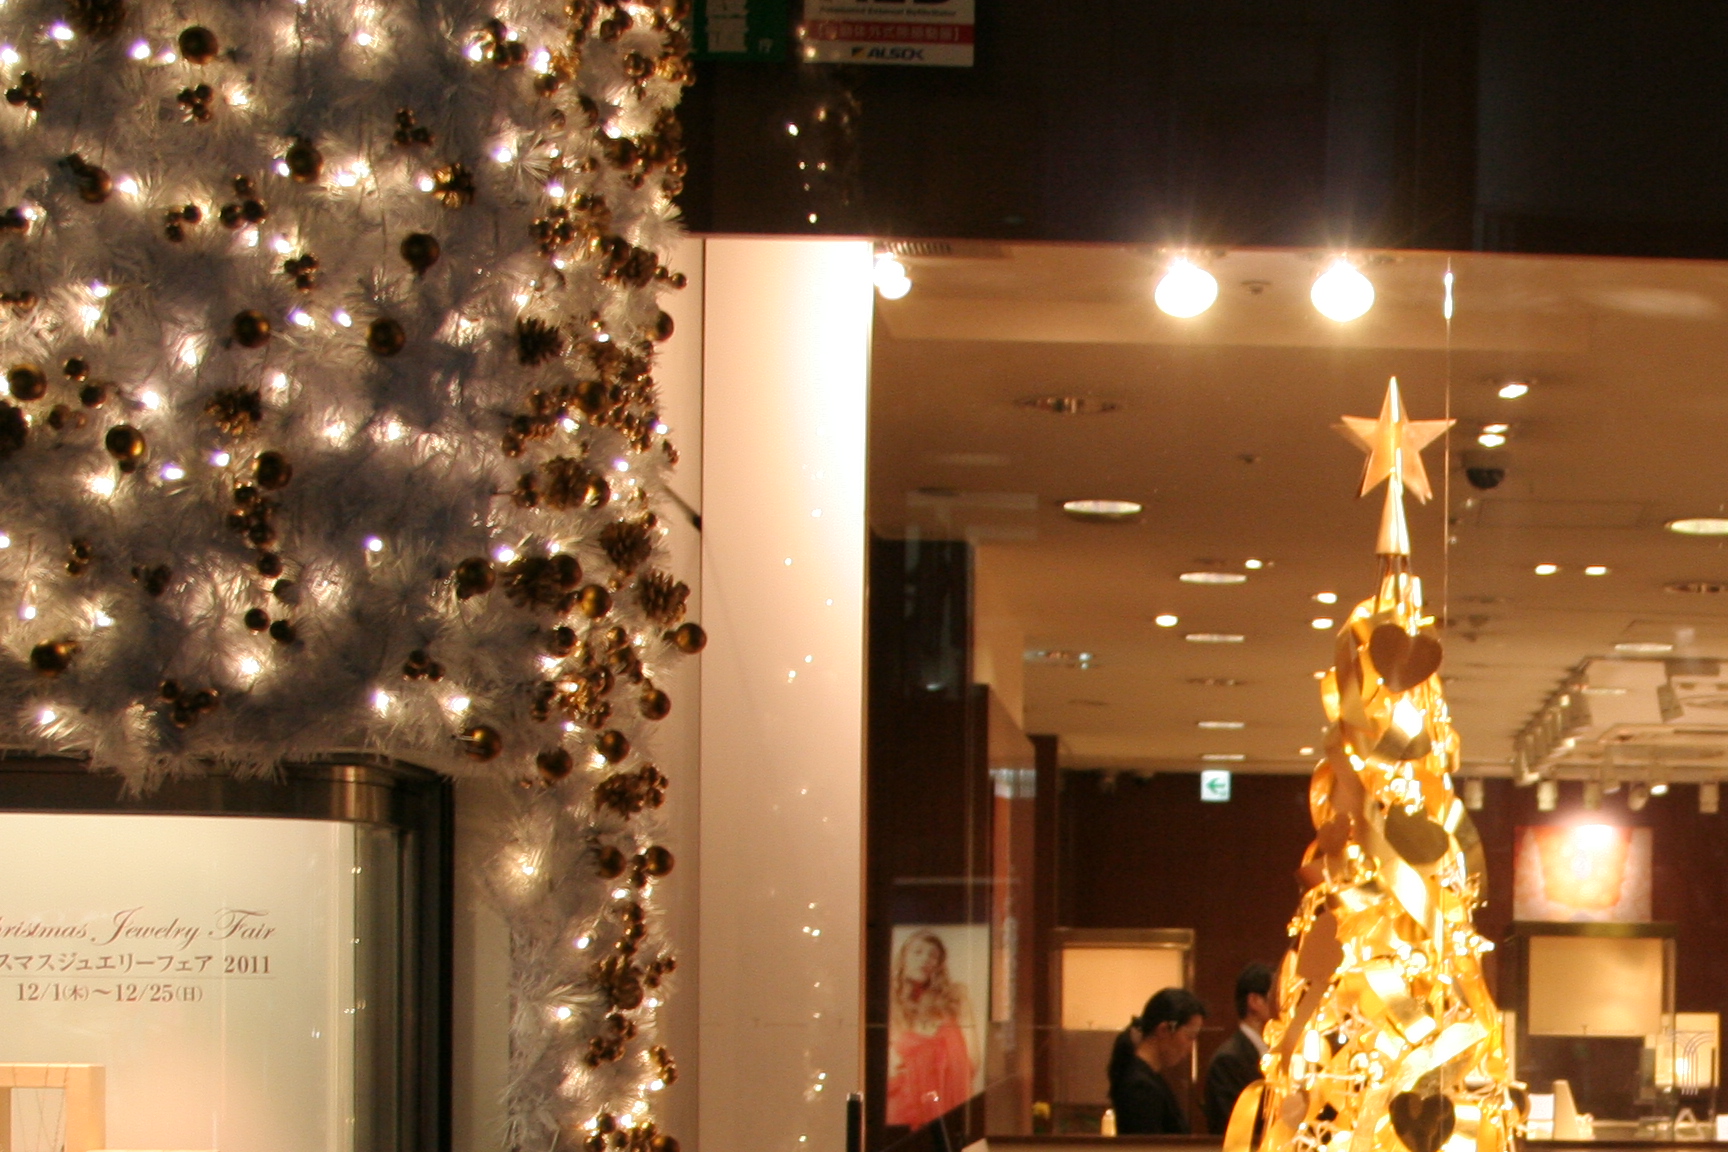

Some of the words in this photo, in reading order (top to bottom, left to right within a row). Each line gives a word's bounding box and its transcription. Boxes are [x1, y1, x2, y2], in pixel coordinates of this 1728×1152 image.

[0, 916, 88, 939] ristmas
[91, 906, 202, 950] Jewelry
[208, 907, 277, 941] Fair
[223, 954, 272, 975] 2011
